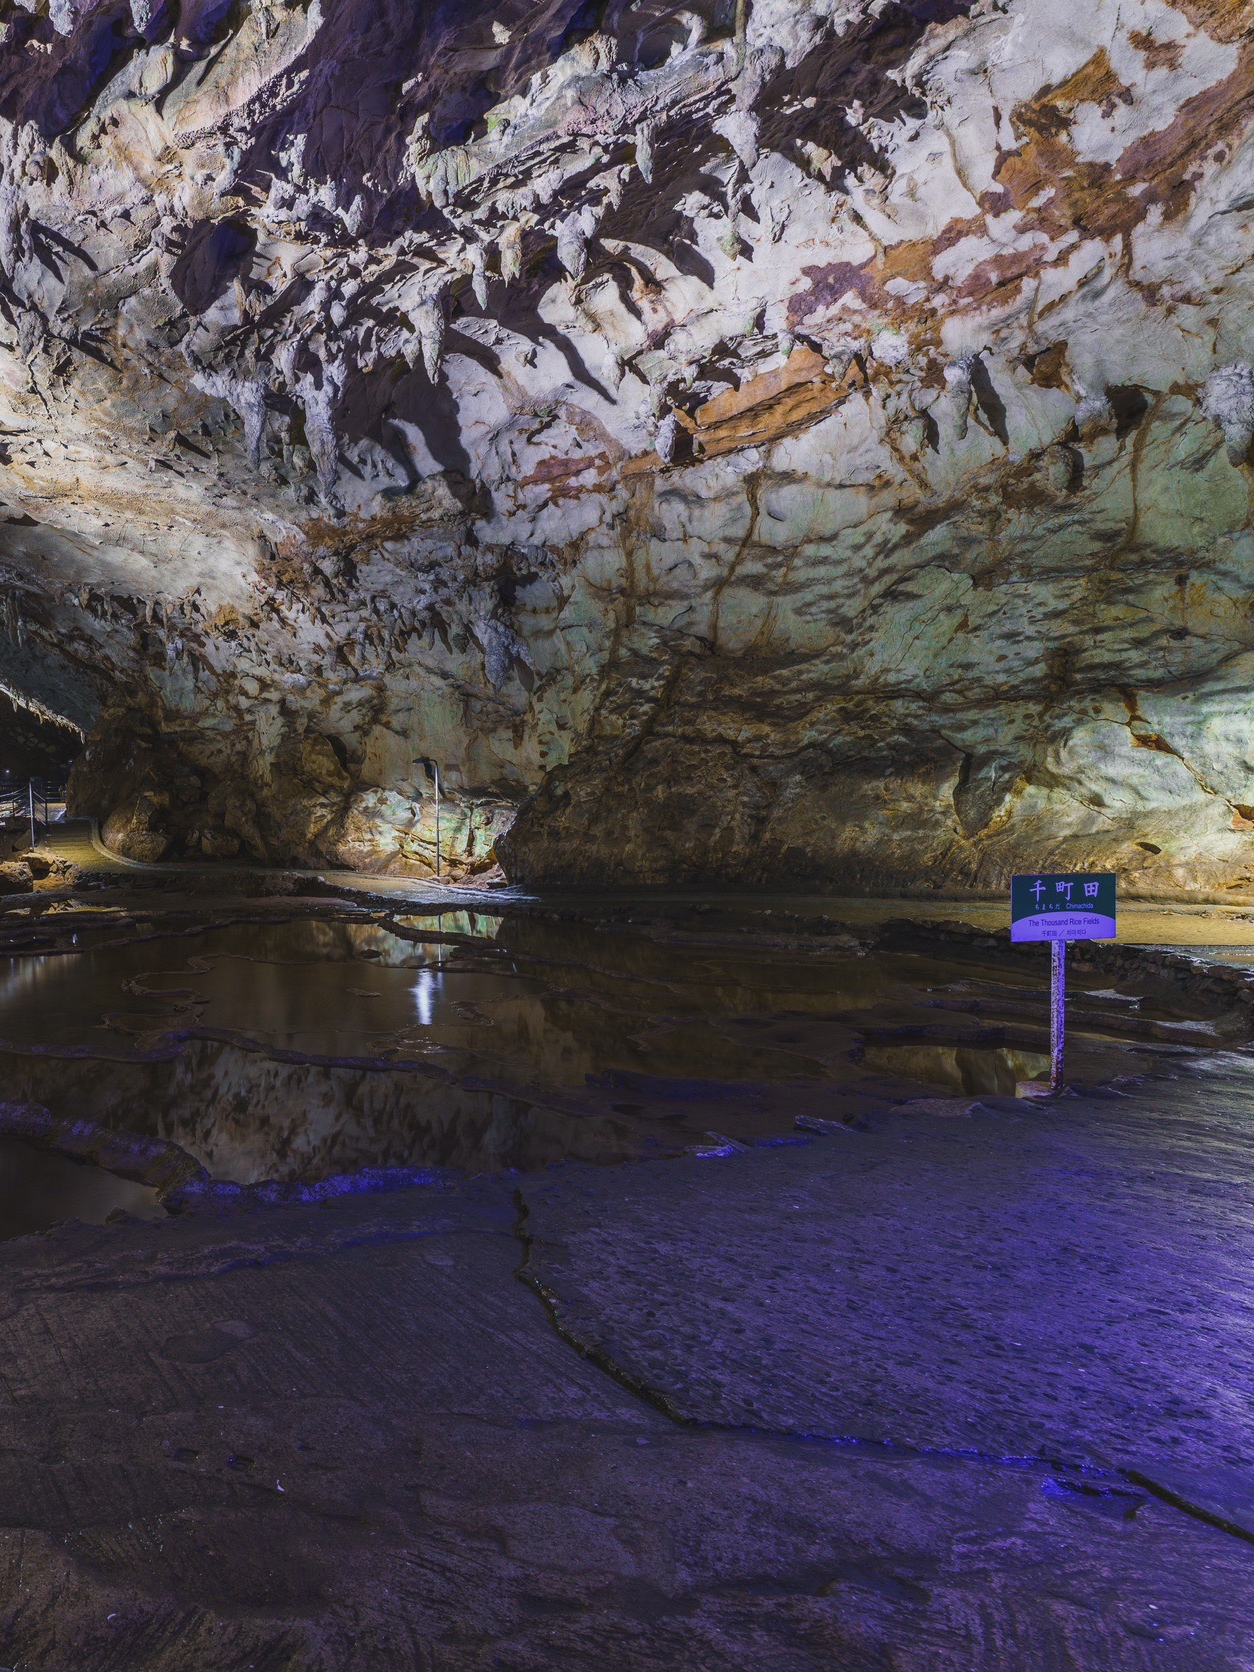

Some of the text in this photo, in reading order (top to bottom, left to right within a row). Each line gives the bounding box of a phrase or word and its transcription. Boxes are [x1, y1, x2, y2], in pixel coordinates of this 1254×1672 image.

[1029, 879, 1100, 902] 千町田
[1041, 918, 1068, 926] Thousand
[1083, 917, 1100, 925] Fields
